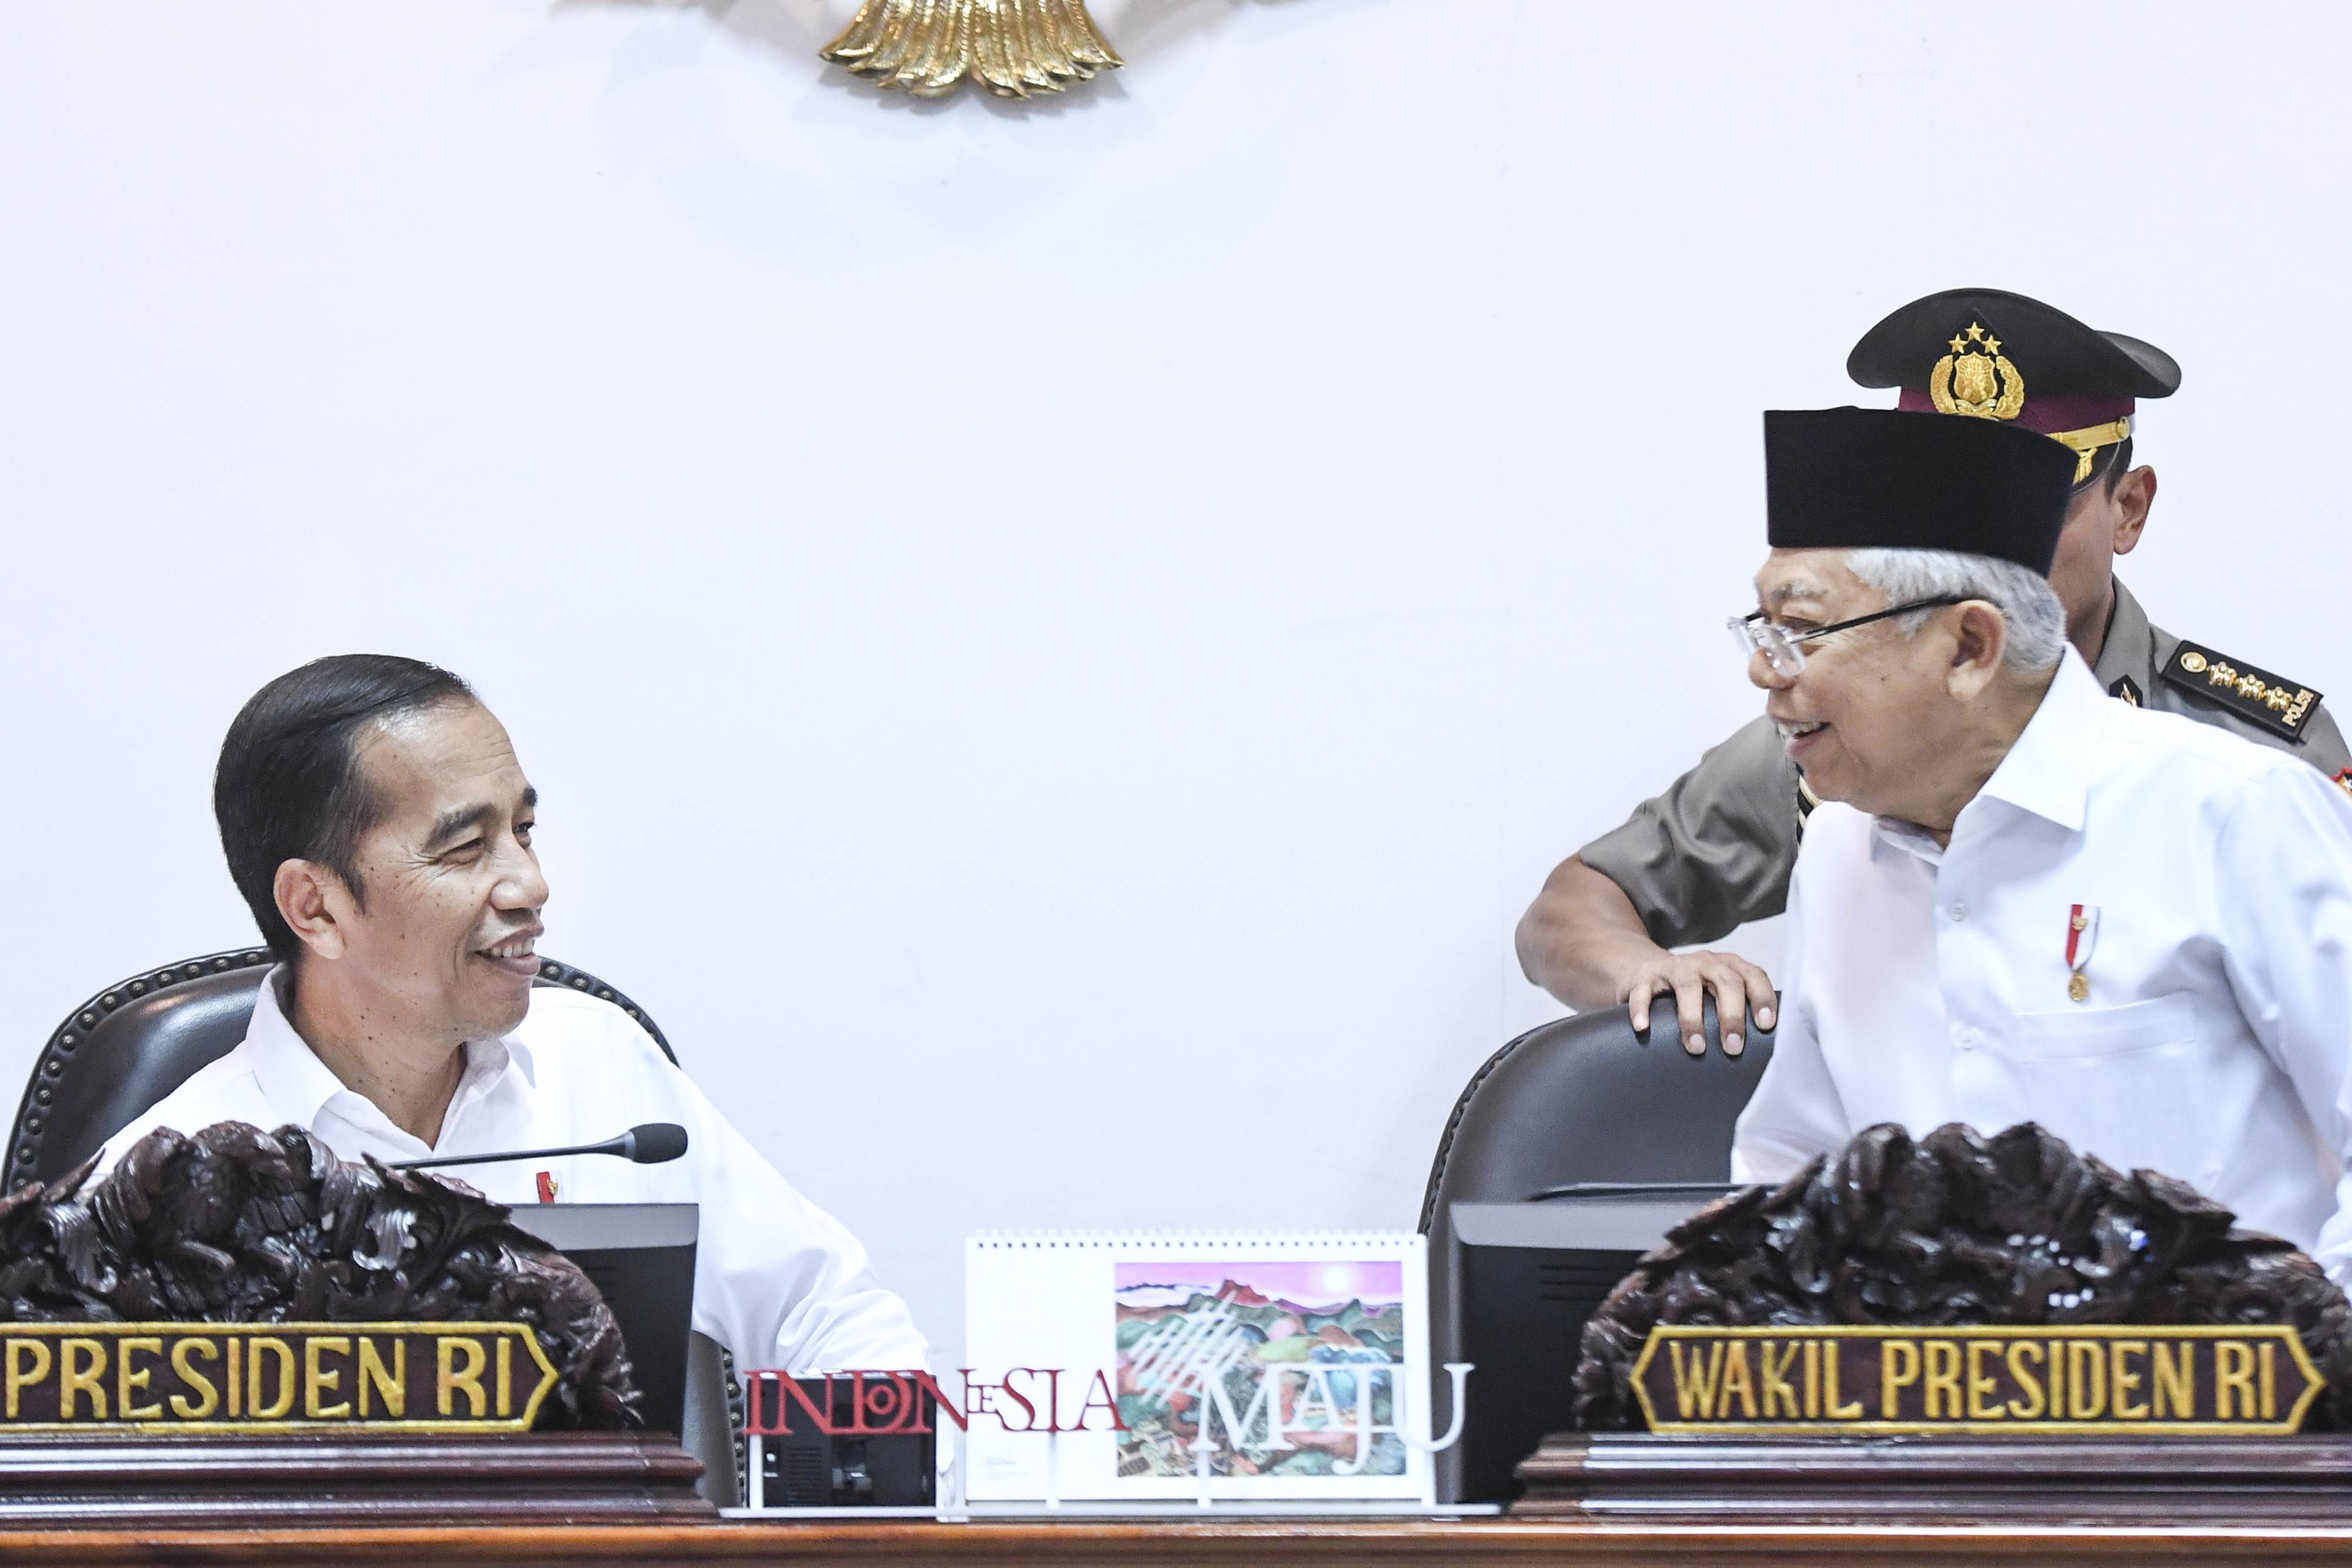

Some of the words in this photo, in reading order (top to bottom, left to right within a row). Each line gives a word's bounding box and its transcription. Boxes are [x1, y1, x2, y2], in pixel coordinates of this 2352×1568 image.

[2282, 688, 2314, 727] POLISI
[6, 1338, 405, 1419] PRESIDEN
[437, 1338, 512, 1417] RI
[744, 1368, 1130, 1435] INDONESIA
[1188, 1362, 1476, 1475] MAJU
[1669, 1339, 1862, 1420] WAKIL
[1881, 1339, 2194, 1420] PRESIDEN
[2215, 1340, 2275, 1419] RI
